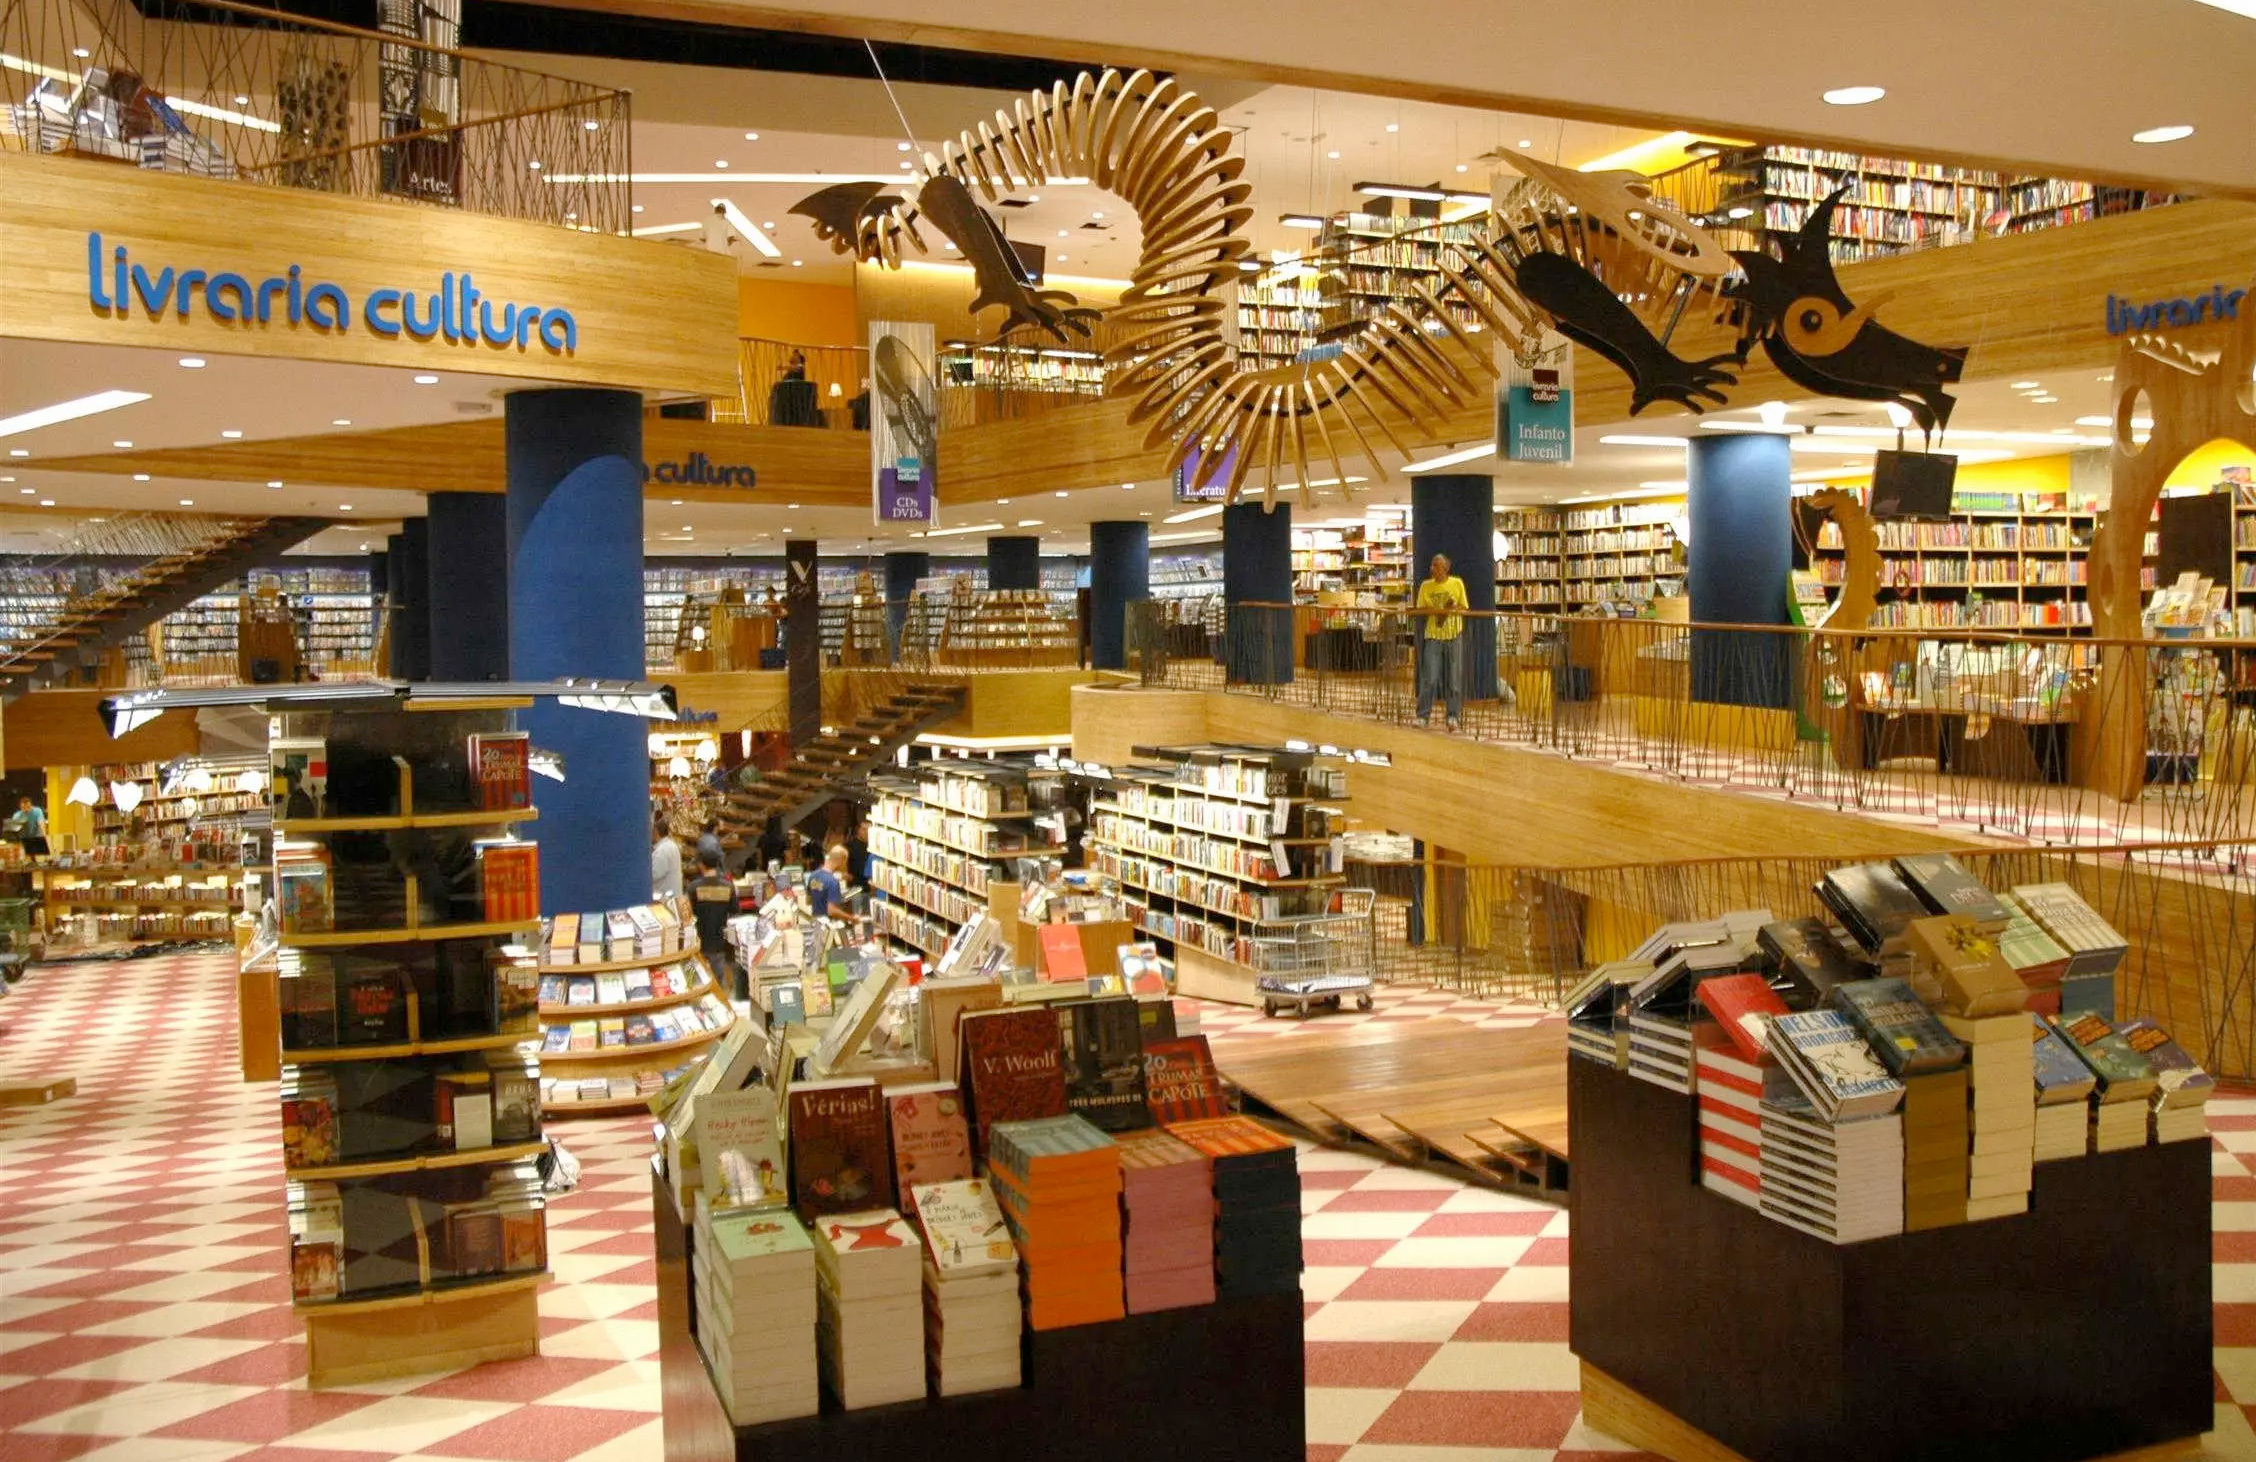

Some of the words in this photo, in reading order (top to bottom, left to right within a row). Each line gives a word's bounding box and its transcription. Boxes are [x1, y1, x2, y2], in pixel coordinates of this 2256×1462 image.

[88, 231, 350, 330] livraria
[365, 271, 577, 351] cultura
[1519, 423, 1565, 439] Infanto
[1519, 442, 1563, 459] Juvenil
[654, 451, 756, 487] cultura
[896, 496, 919, 508] CDs
[892, 507, 924, 519] DVDs
[1004, 1048, 1058, 1073] Woolf
[1143, 1052, 1167, 1075] 20
